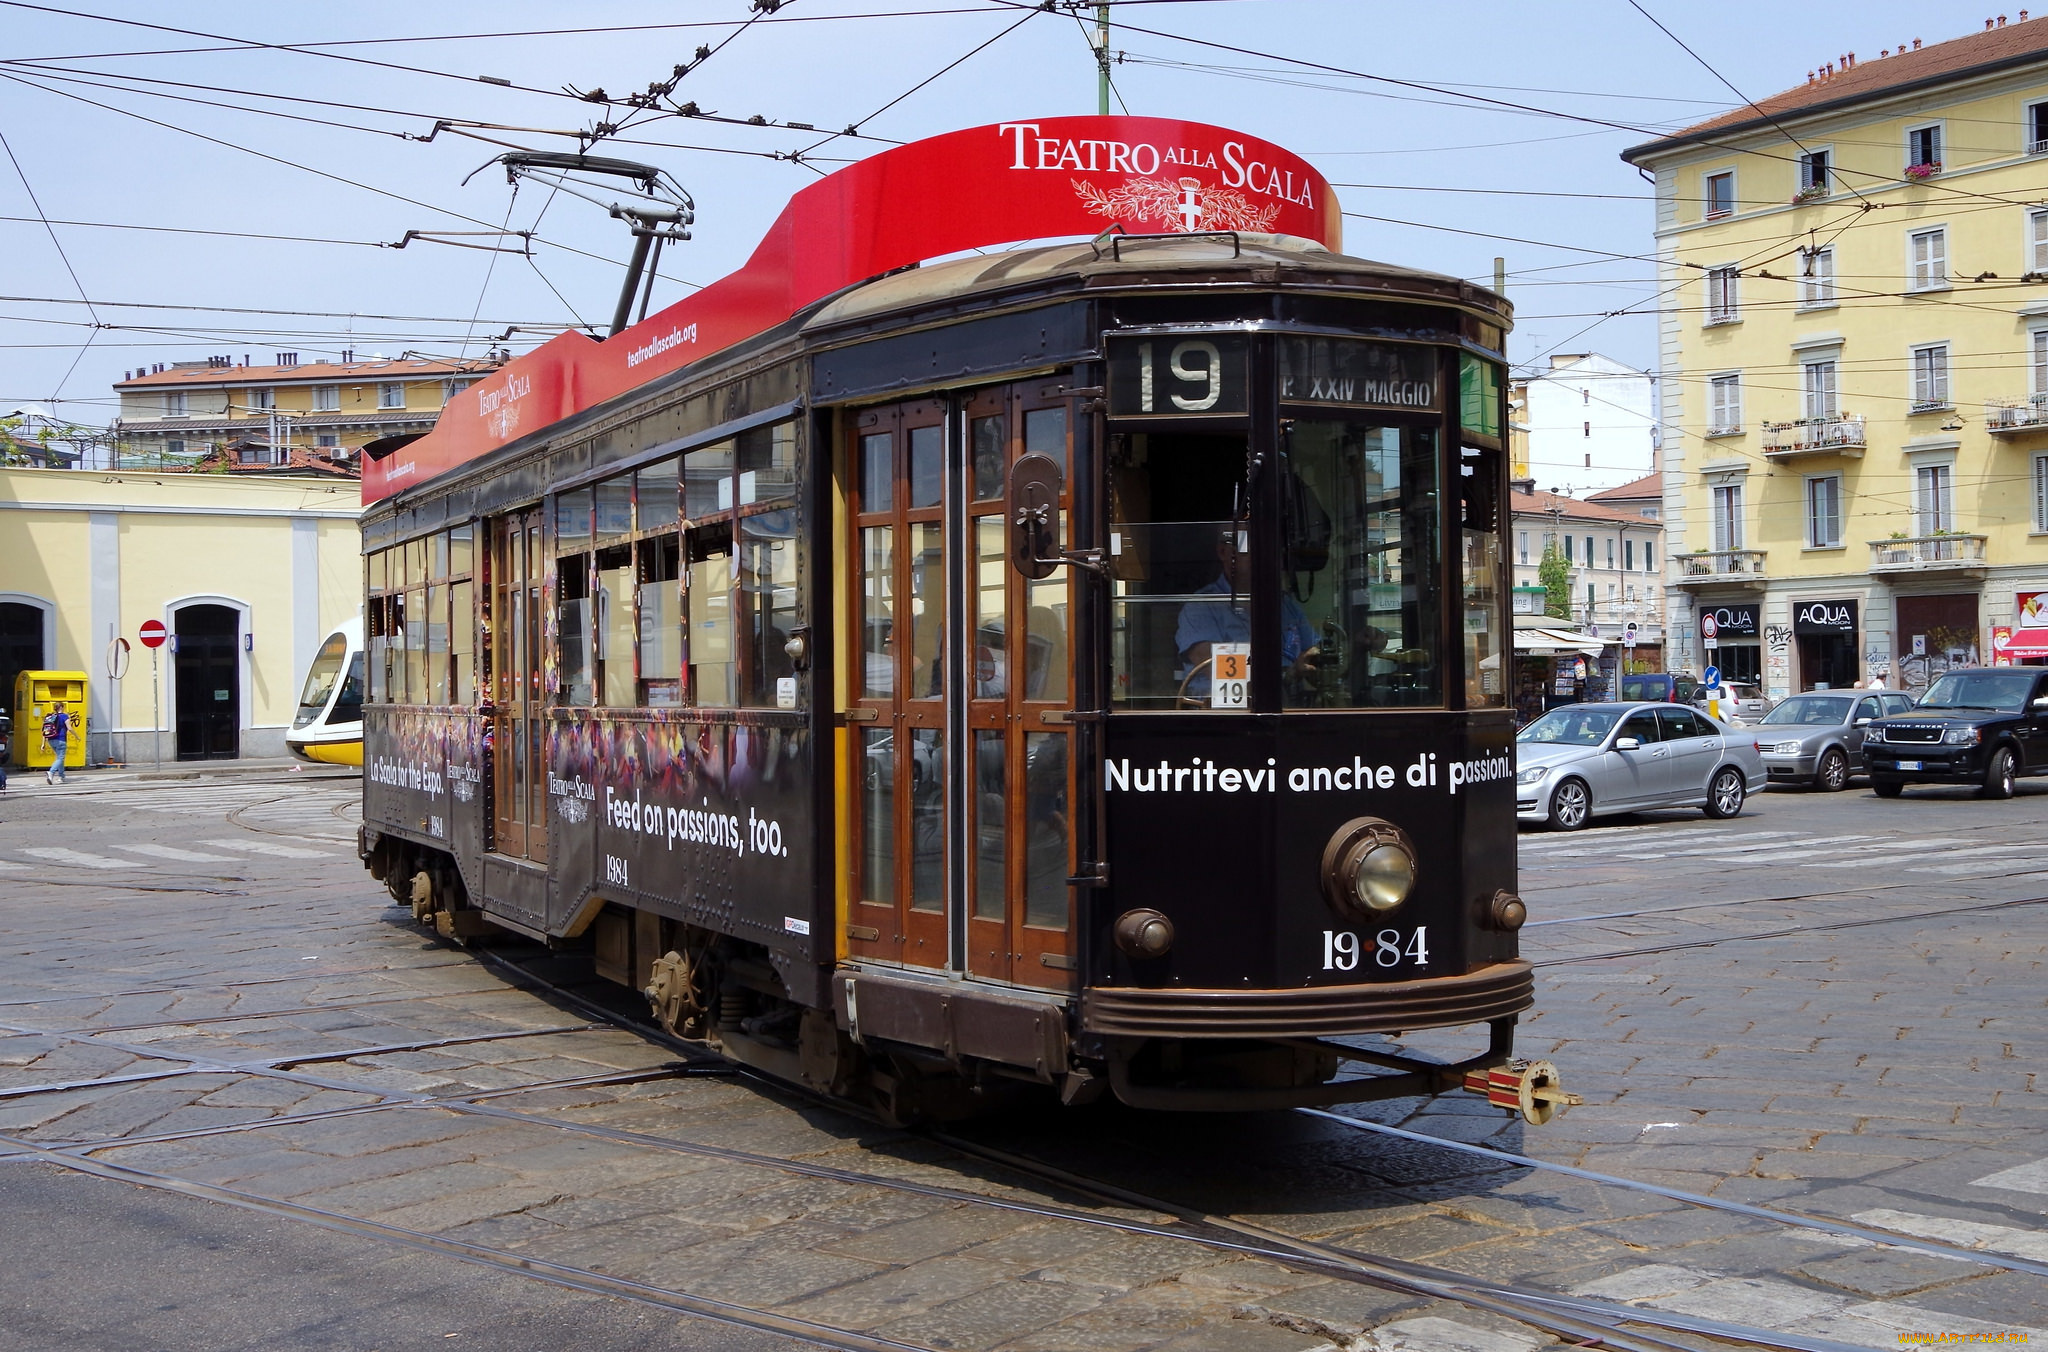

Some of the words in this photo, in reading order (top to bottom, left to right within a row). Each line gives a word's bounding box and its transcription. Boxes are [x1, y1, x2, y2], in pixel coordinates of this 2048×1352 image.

[999, 123, 1160, 175] TEATRO
[1163, 147, 1218, 170] ALLA
[1222, 141, 1314, 210] SCALA
[627, 322, 697, 369] teatroallascala.org
[1138, 341, 1221, 411] 19
[1309, 377, 1354, 401] XXIV
[1364, 379, 1431, 406] MAGGIO
[1715, 608, 1753, 628] QUA
[1799, 603, 1851, 625] AQUA
[1225, 657, 1237, 678] 3
[1219, 682, 1244, 704] 19
[370, 755, 379, 782] La
[379, 755, 397, 785] Scala
[397, 758, 408, 788] for
[409, 759, 421, 791] the
[423, 762, 444, 802] Expo.
[1105, 757, 1277, 793] Nutritevi
[1288, 755, 1395, 792] anche
[1405, 752, 1437, 788] di
[1449, 745, 1513, 794] passioni.
[431, 815, 443, 838] 1984
[606, 786, 641, 832] Feed
[644, 804, 664, 836] on
[667, 796, 744, 858] passions,
[748, 806, 788, 858] too.
[606, 854, 629, 886] 1984
